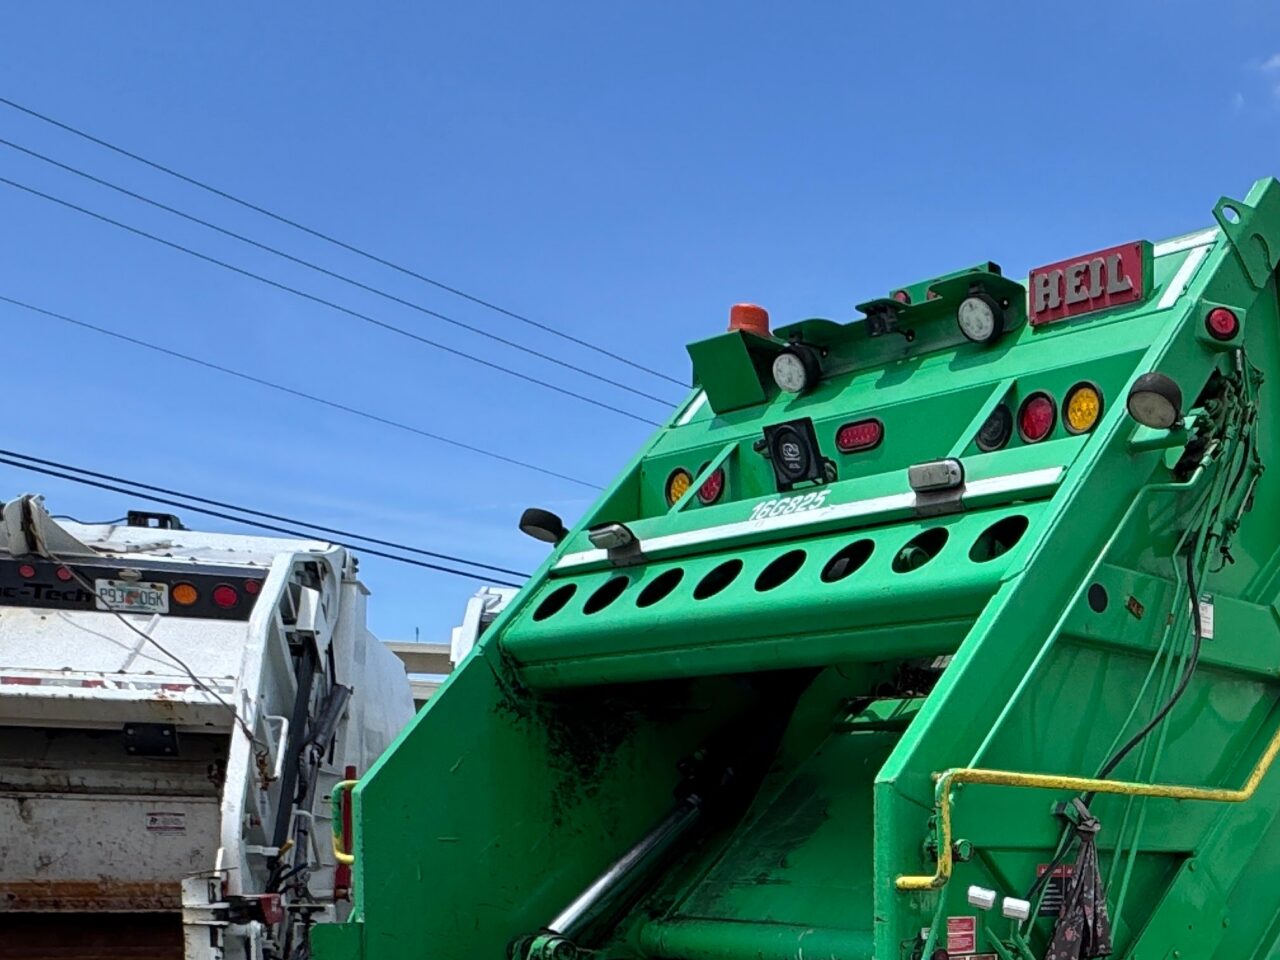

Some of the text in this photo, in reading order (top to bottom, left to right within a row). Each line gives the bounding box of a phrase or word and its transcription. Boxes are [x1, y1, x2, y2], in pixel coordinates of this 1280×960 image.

[1034, 253, 1133, 313] HEIL
[749, 489, 832, 521] 16G825
[0, 582, 92, 602] c-Tech
